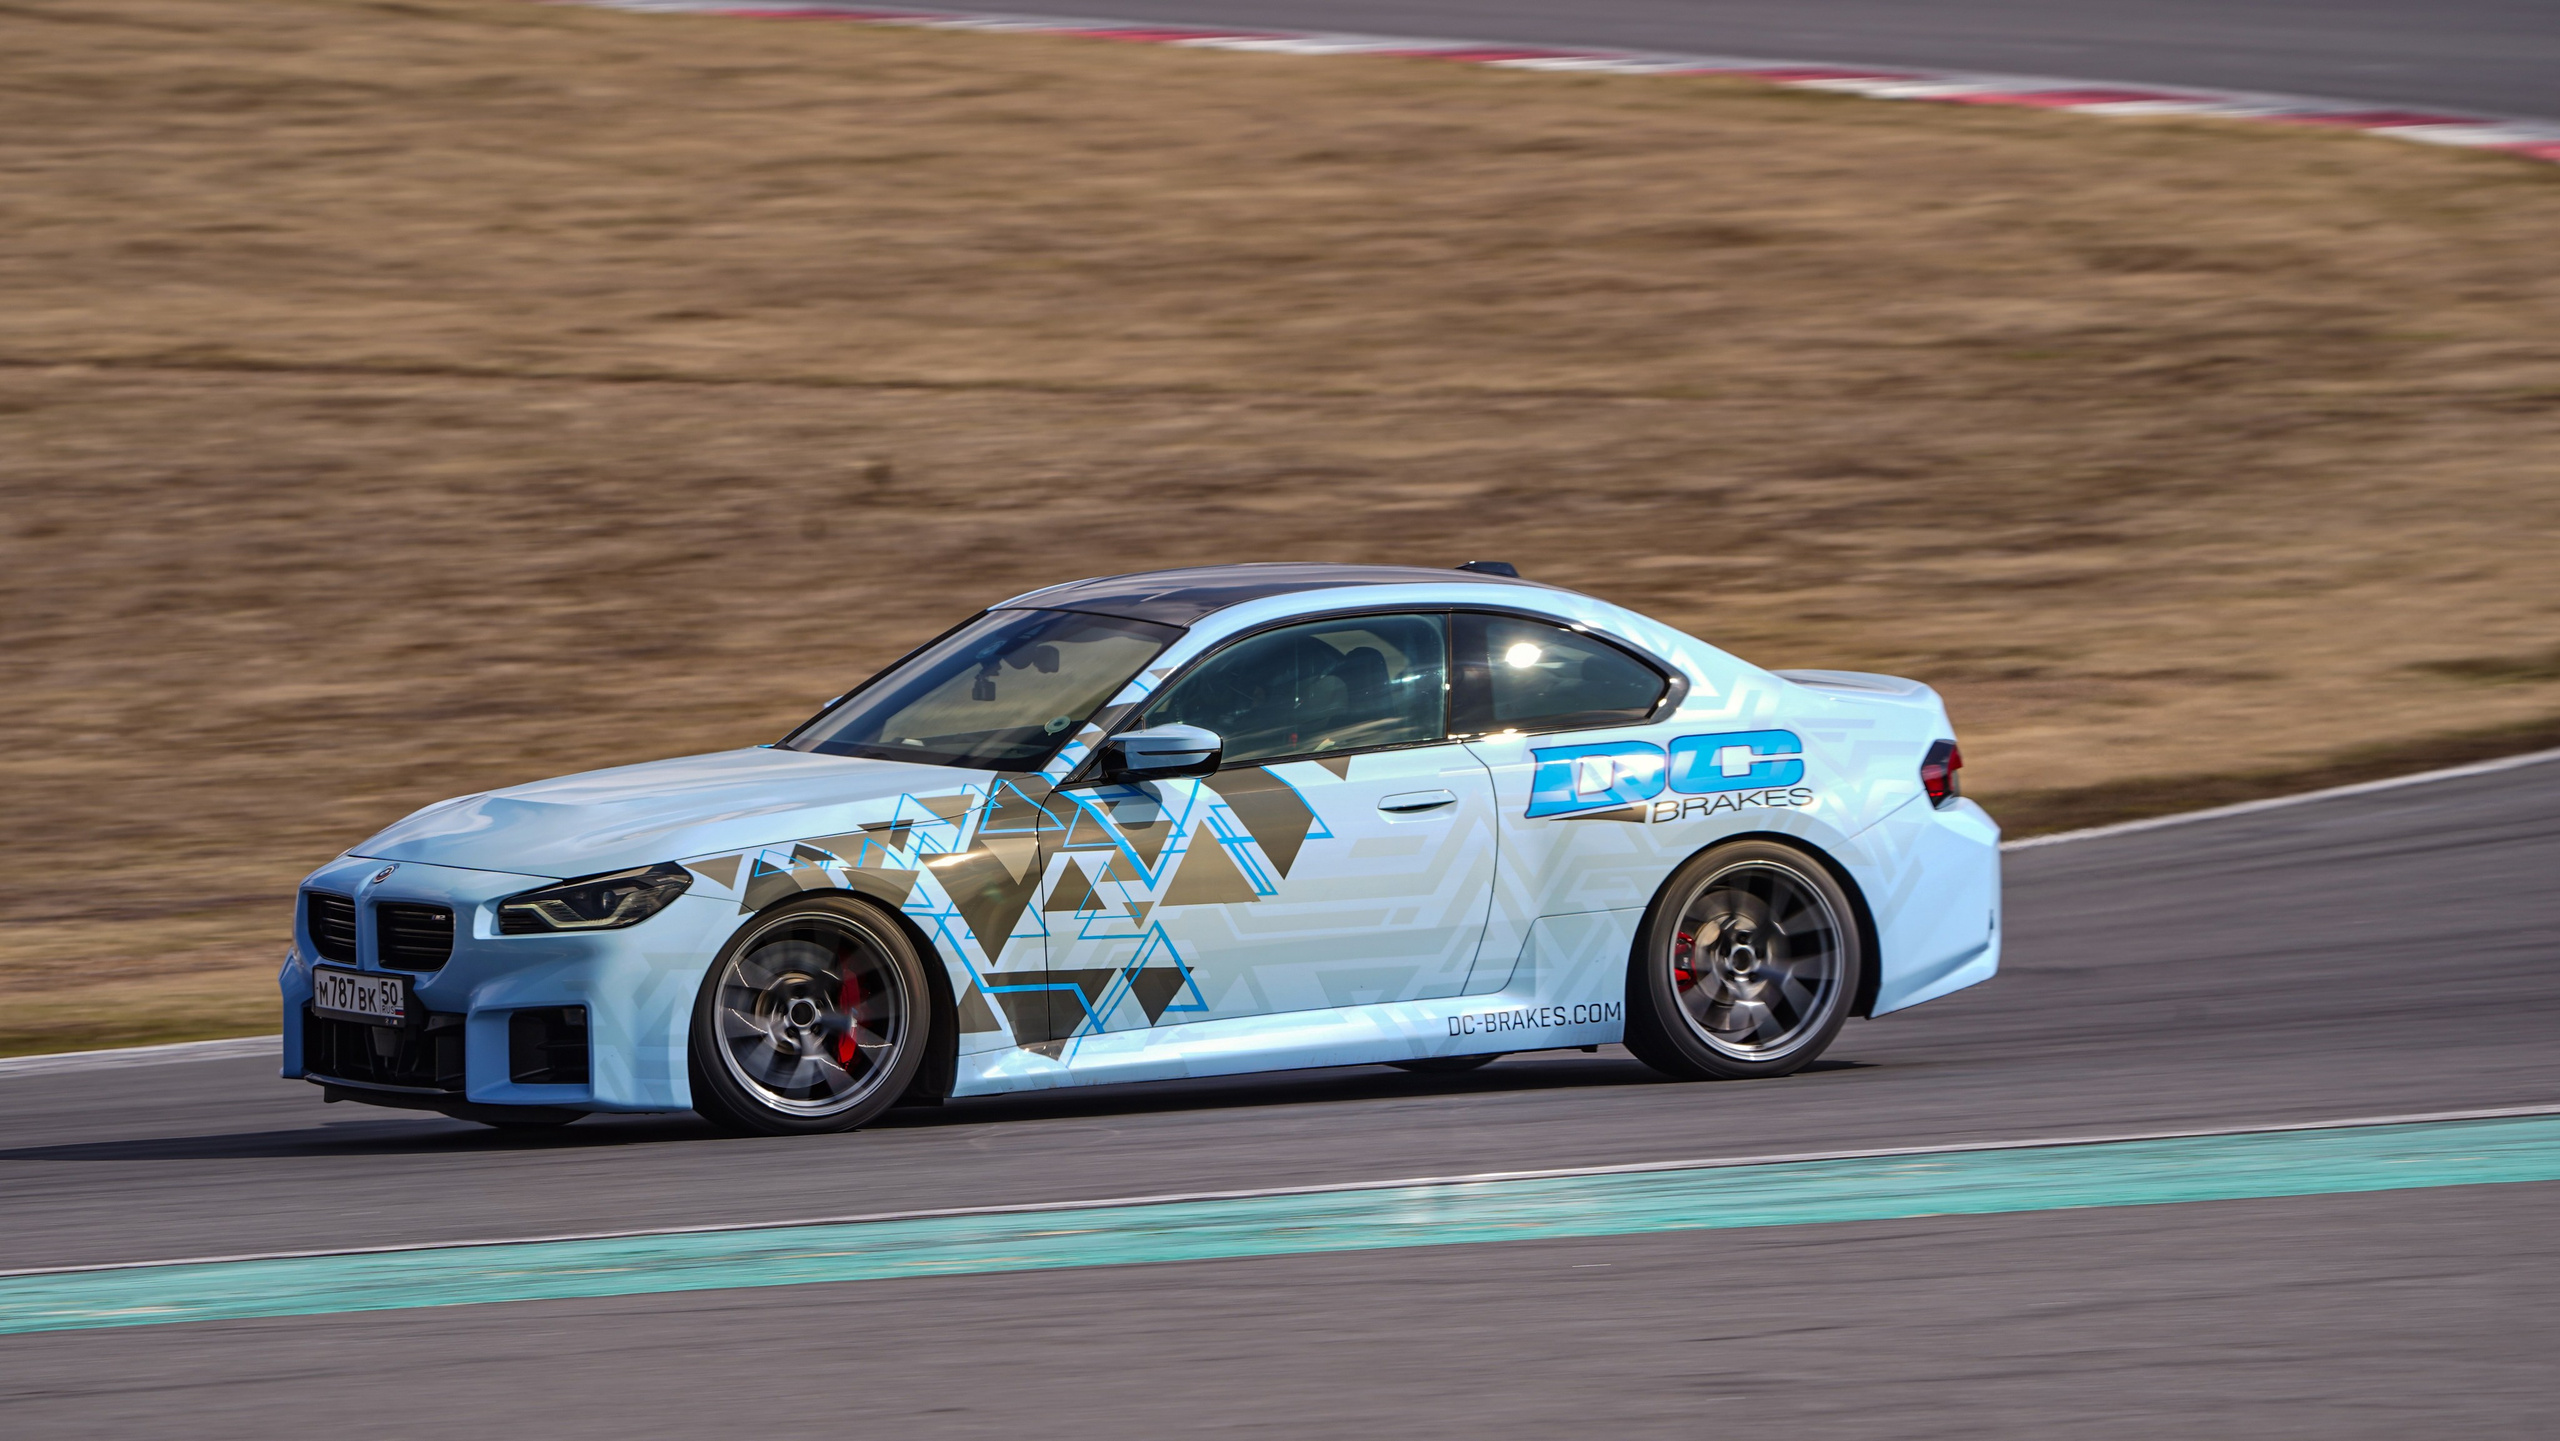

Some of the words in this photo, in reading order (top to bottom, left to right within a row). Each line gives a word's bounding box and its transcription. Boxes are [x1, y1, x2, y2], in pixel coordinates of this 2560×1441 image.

[1524, 729, 1805, 819] DC
[1652, 787, 1814, 824] BRAKES
[319, 975, 377, 1013] M787BK
[380, 981, 398, 1006] 50
[382, 1004, 395, 1015] RUS
[1448, 1001, 1621, 1036] DC-BRAKES.COM
